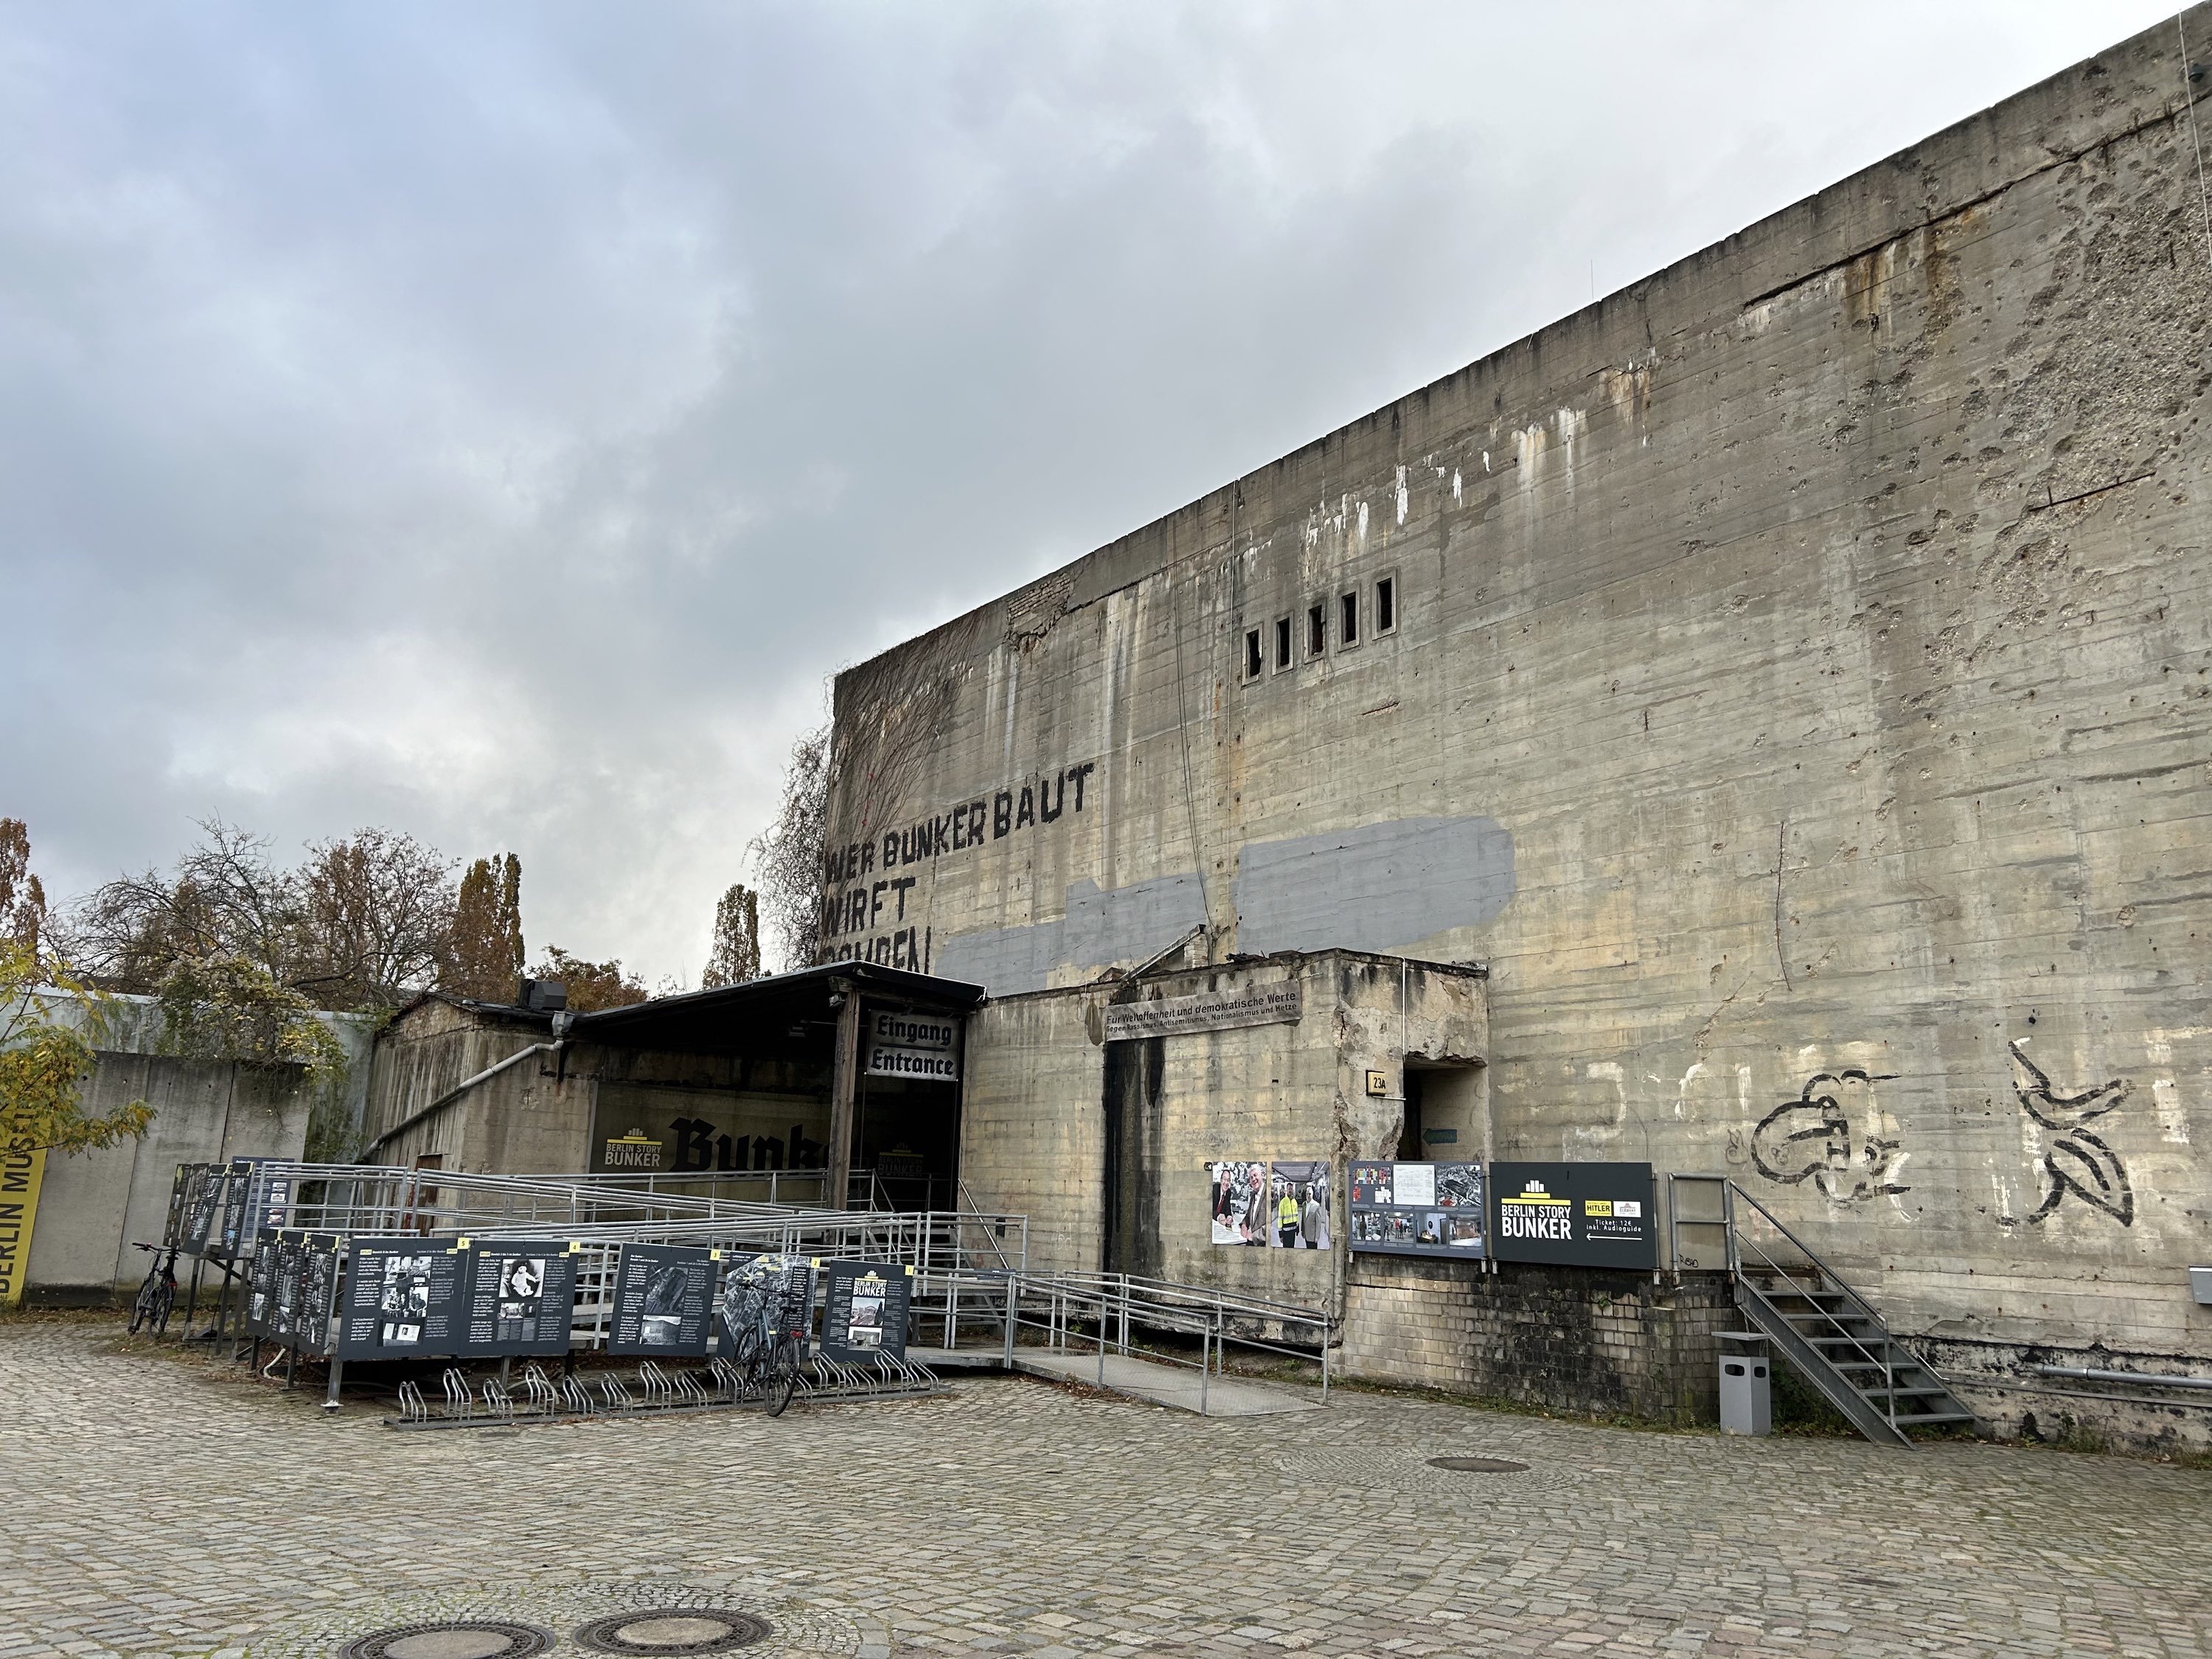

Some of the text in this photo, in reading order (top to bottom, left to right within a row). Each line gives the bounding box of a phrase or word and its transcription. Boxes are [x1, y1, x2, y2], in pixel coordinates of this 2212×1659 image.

[825, 763, 1094, 883] WER BUNKER BAUT
[820, 877, 916, 937] WIRFT
[1122, 1009, 1175, 1023] Weltoffenheit
[1177, 1006, 1193, 1016] und
[1195, 997, 1265, 1015] demokratische
[1267, 992, 1296, 1004] Werte
[1160, 1017, 1209, 1027] Antisemitismus,
[1211, 1009, 1259, 1021] Nationalismus
[1261, 1006, 1273, 1015] und
[1276, 1004, 1297, 1012] Hetze
[876, 1015, 952, 1046] Eingang
[871, 1048, 954, 1076] Entrance
[1374, 1077, 1386, 1089] 23A
[606, 1144, 662, 1153] BERLIN STORY
[669, 1117, 830, 1177] Bunk
[605, 1152, 661, 1166] BUNKER
[1501, 1205, 1571, 1219] BERLIN STORY
[1502, 1217, 1572, 1240] BUNKER
[1604, 1225, 1641, 1233] Audioguide
[853, 1286, 886, 1297] BUNKER
